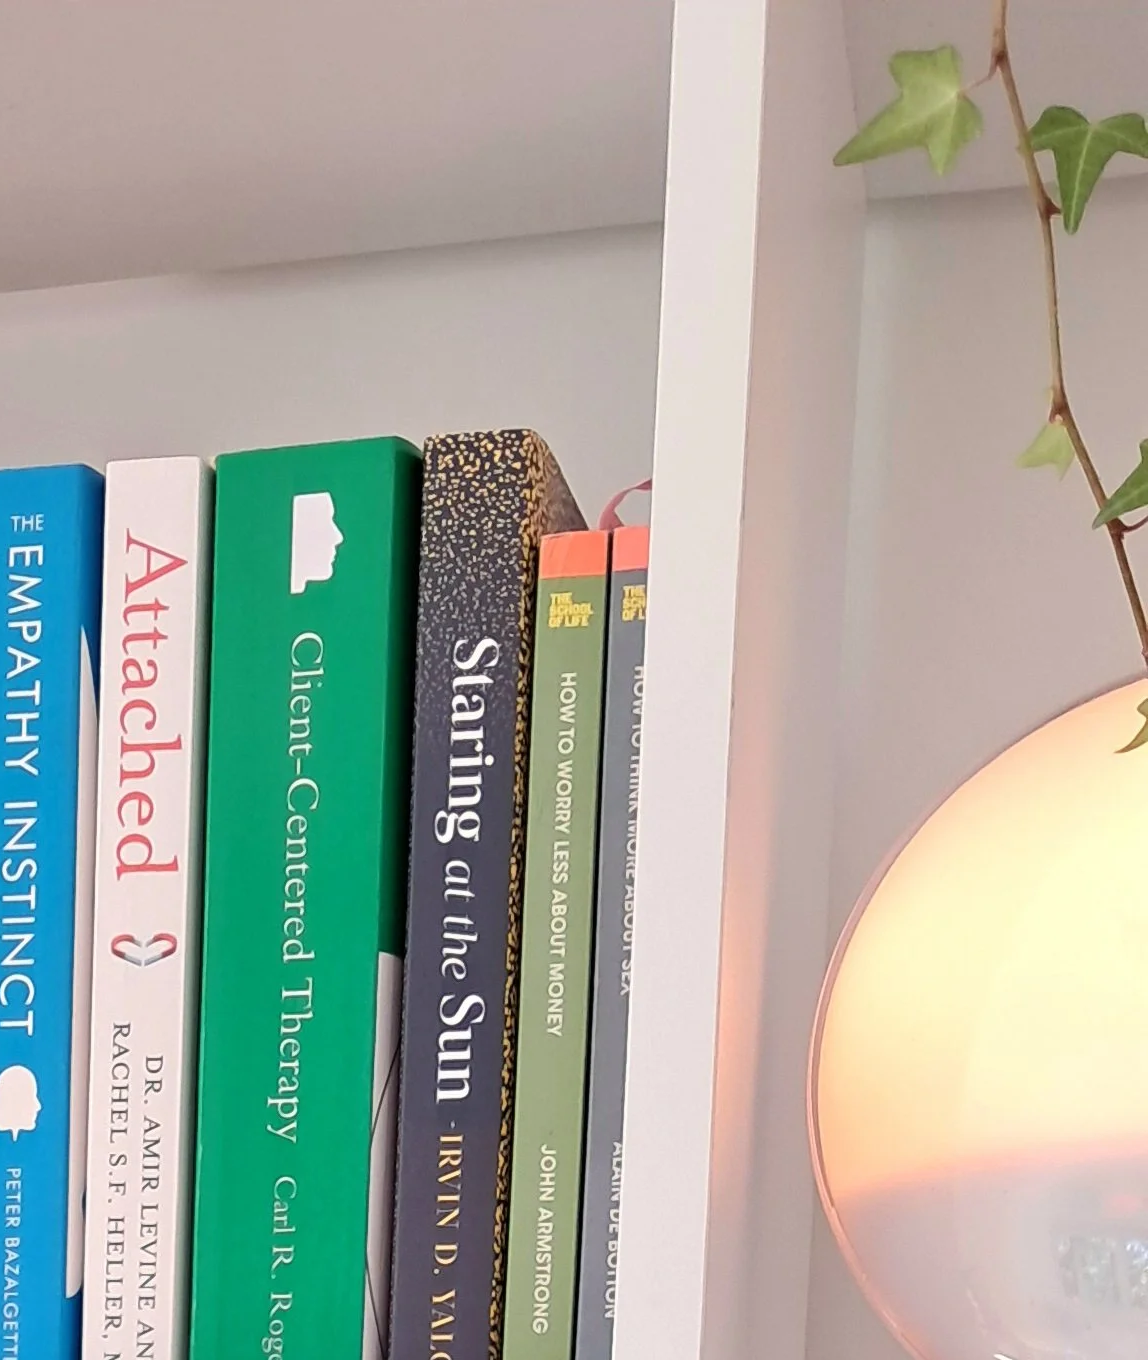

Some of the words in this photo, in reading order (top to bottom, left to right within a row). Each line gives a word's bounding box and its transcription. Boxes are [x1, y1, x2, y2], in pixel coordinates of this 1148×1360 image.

[10, 513, 45, 533] THE
[4, 543, 44, 777] EMPATHY
[557, 672, 577, 723] HOW
[115, 527, 190, 882] Attached
[434, 636, 501, 844] Staring
[556, 728, 576, 755] TO
[279, 631, 326, 963] Client-Centered
[554, 758, 575, 833] WORRY
[442, 859, 474, 901] at
[551, 840, 571, 885] LESS
[439, 913, 480, 981] the
[548, 889, 568, 957] ABOUT
[545, 962, 566, 1038] MONEY
[143, 1054, 165, 1104] DR.
[266, 976, 316, 1144] Therapy
[433, 993, 487, 1104] Sun
[139, 1116, 162, 1193] AMIR
[538, 1143, 557, 1202] JOHN
[4, 1167, 23, 1228] PETER
[135, 1203, 159, 1311] LEVINE
[531, 1207, 555, 1335] ARMSTRONG
